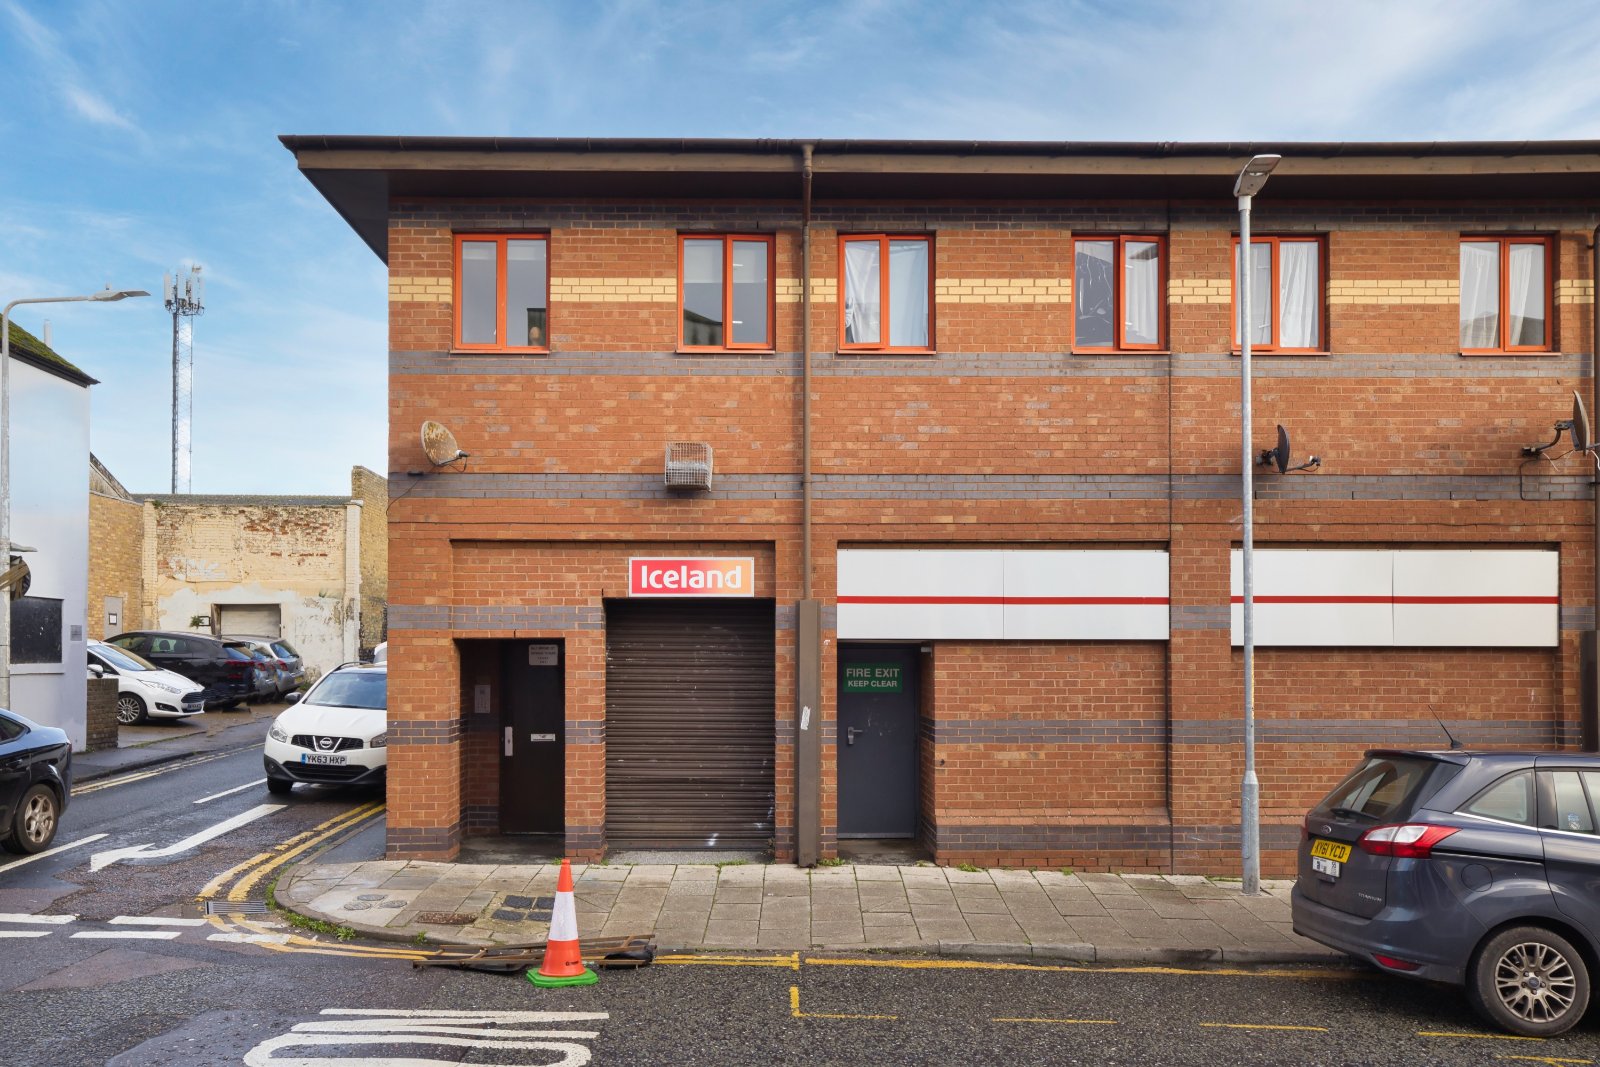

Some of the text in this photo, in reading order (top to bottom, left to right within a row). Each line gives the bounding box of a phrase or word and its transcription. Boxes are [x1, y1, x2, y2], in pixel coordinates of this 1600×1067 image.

[641, 565, 742, 589] Iceland
[846, 668, 900, 678] FIRE EXIT
[329, 756, 346, 765] HXP
[1329, 843, 1346, 859] YCD
